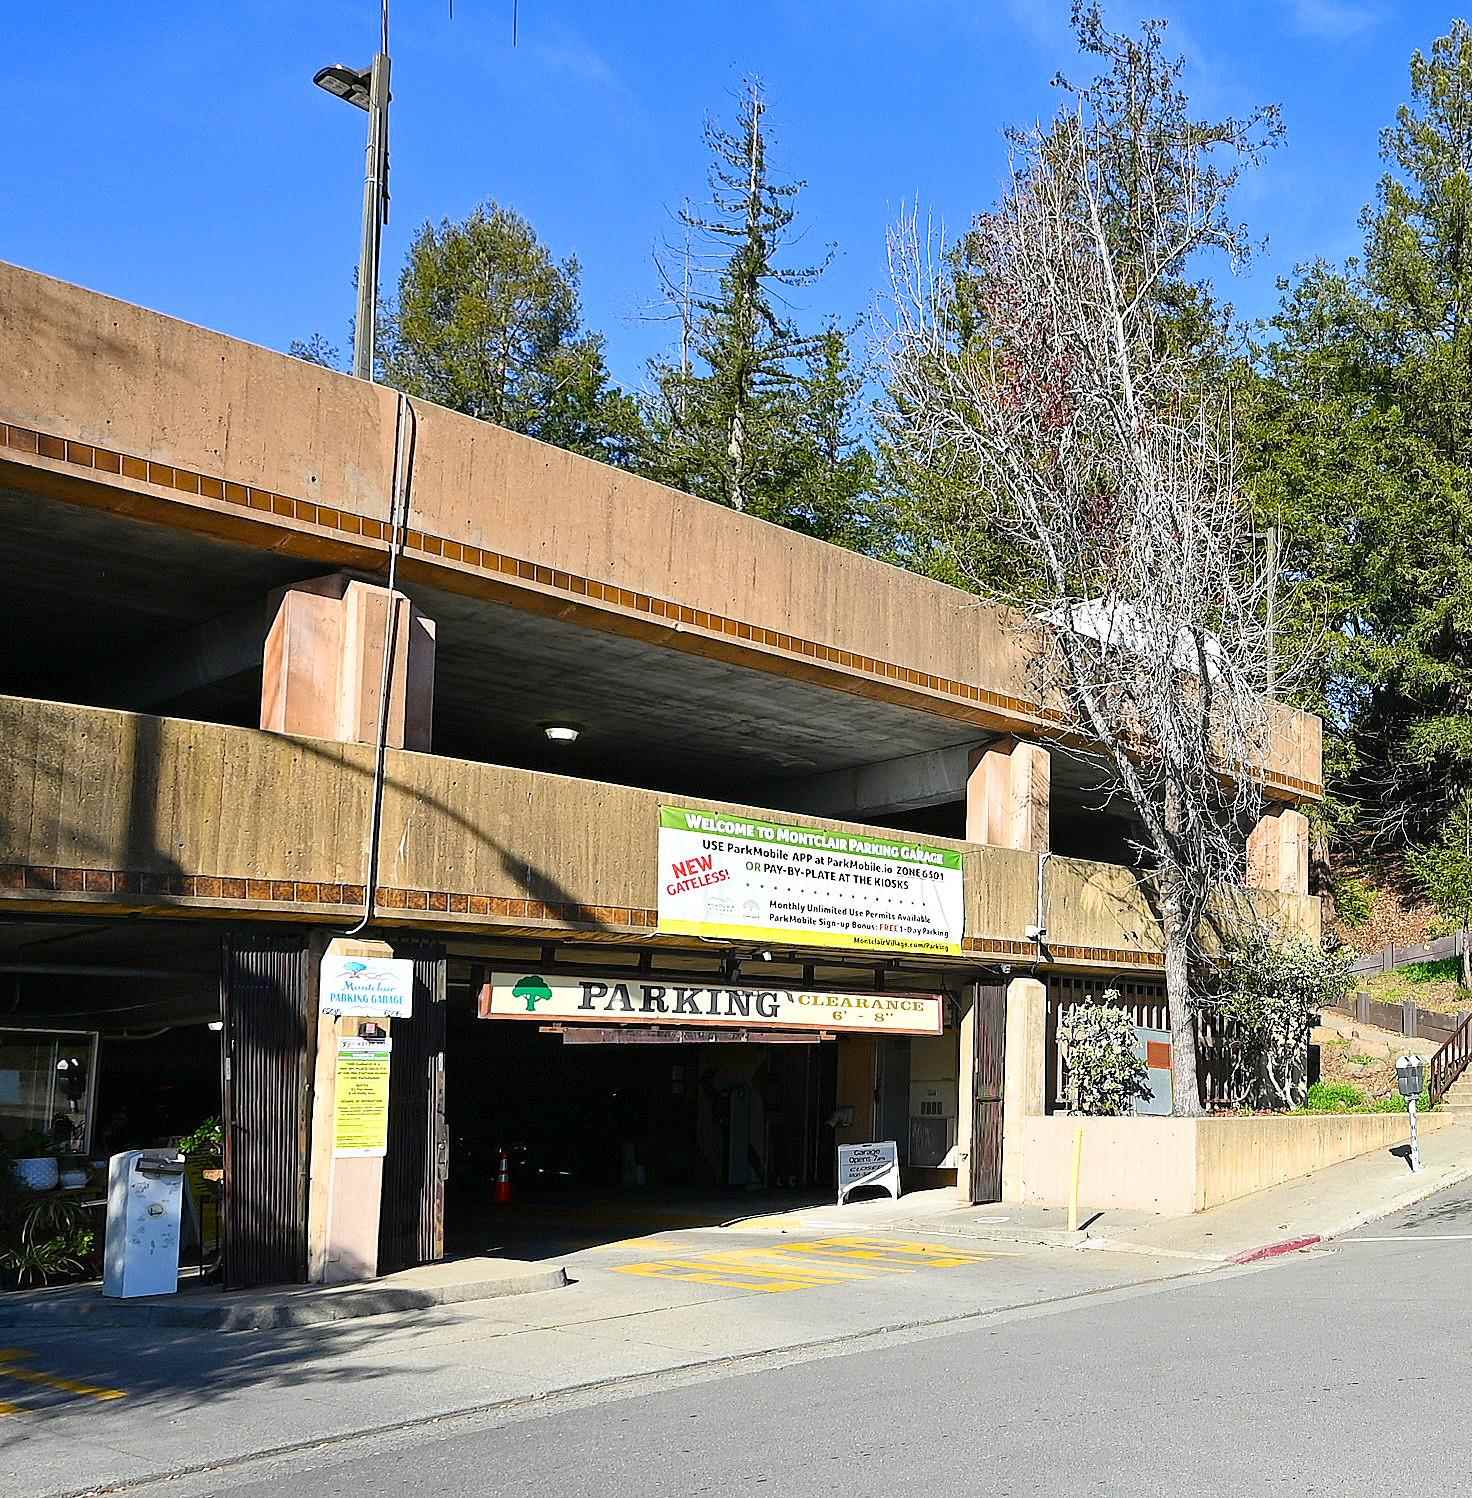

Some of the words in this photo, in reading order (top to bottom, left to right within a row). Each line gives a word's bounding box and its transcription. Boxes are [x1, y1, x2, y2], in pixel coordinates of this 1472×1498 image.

[757, 826, 774, 840] TO
[672, 854, 713, 879] NEW
[702, 839, 724, 852] USE
[727, 844, 789, 861] ParkMobile
[792, 852, 813, 863] APP
[814, 856, 825, 866] at
[827, 857, 893, 875] ParkMobile.io
[896, 865, 920, 877] ZONE
[922, 869, 944, 881] 6501
[666, 868, 731, 896] GATELESS!
[745, 861, 761, 872] OR
[763, 863, 836, 881] PAY-BY-PLATE
[838, 873, 851, 883] AT
[853, 874, 872, 886] THE
[874, 877, 909, 890] KIOSKS
[769, 900, 806, 914] Monthly
[807, 904, 848, 915] Unlimited
[849, 908, 864, 917] Use
[865, 909, 896, 921] Permits
[897, 913, 931, 924] Available
[769, 913, 817, 925] ParkMobile
[818, 918, 850, 930] Sign-up
[851, 921, 878, 931] Bonus:
[879, 923, 897, 932] FREE
[899, 925, 921, 936] 1-Day
[922, 927, 949, 939] Parking
[330, 992, 368, 1004] PARKING
[371, 994, 405, 1005] GARAGE
[577, 981, 780, 1018] PARKING
[798, 994, 924, 1012] CLEARANCE
[832, 1010, 847, 1021] 6'
